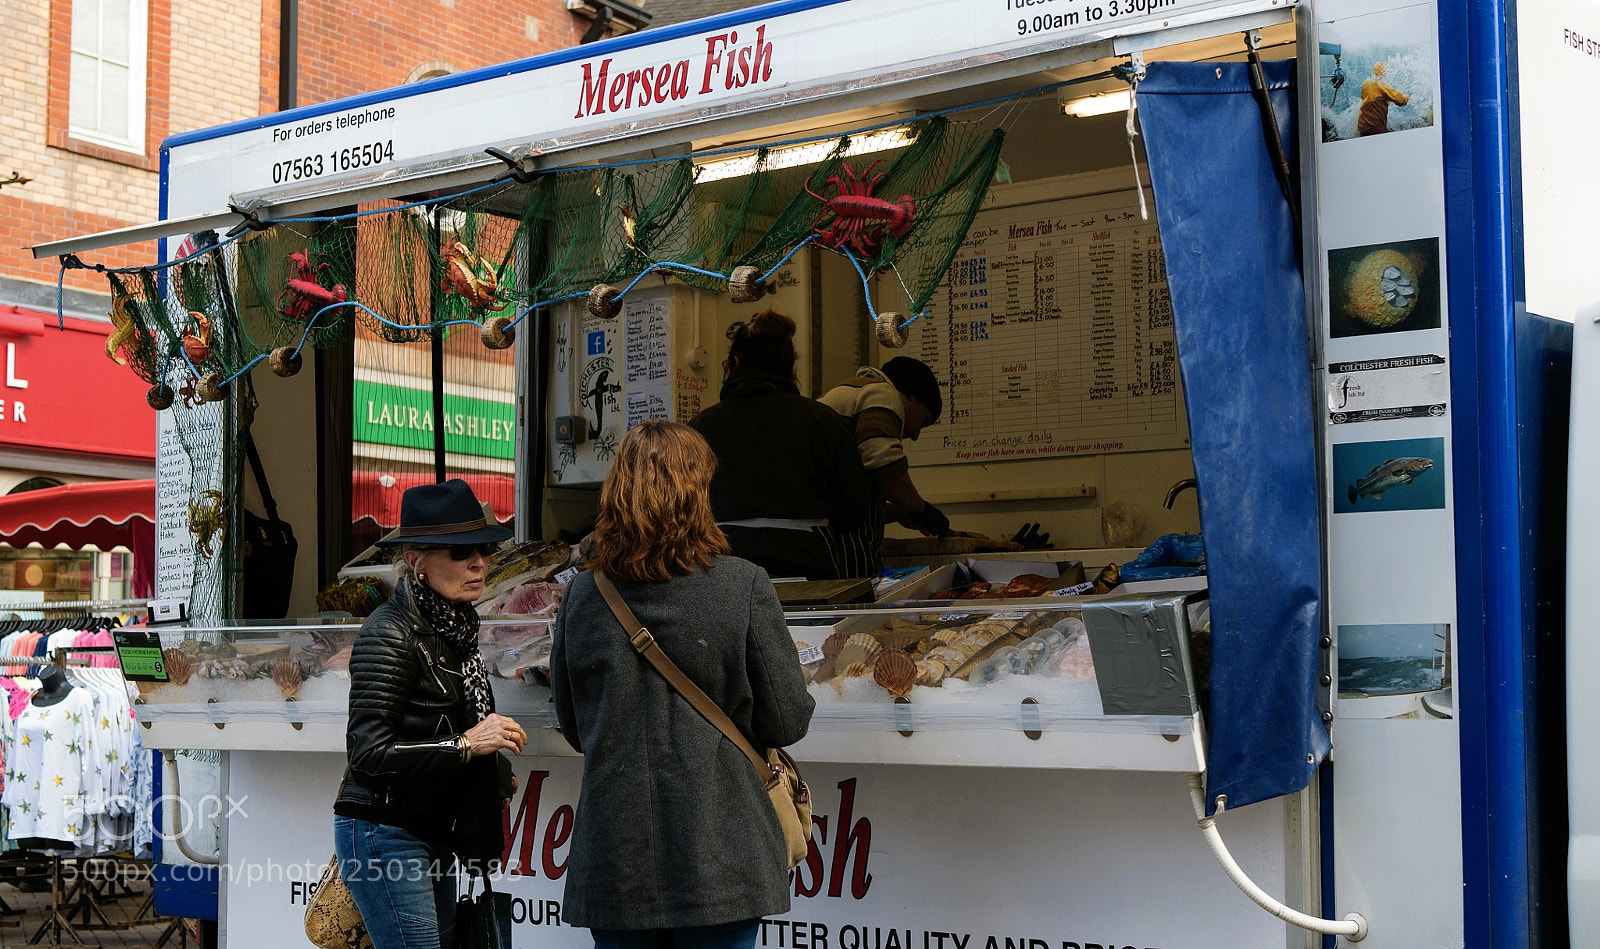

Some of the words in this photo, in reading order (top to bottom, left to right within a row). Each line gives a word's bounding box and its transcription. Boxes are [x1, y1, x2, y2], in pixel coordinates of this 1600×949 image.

[1017, 11, 1079, 35] 9.00am
[1085, 5, 1103, 22] to
[1108, 0, 1176, 17] 3.30pm
[1563, 27, 1584, 52] FISH
[574, 58, 690, 119] Mersea
[698, 24, 773, 95] Fish
[273, 128, 292, 142] For
[295, 120, 332, 138] orders
[336, 107, 396, 129] telephone
[273, 154, 323, 184] 07563
[330, 139, 395, 172] 165504
[1008, 224, 1034, 240] Mersea
[1035, 219, 1053, 236] Fish
[959, 238, 987, 249] heaper
[6, 342, 29, 389] L
[1001, 364, 1017, 374] Smoked
[1018, 363, 1028, 372] Fish
[1340, 361, 1389, 372] COLCHESTER
[1390, 359, 1415, 368] FRESH
[1416, 356, 1433, 365] FISH
[580, 358, 610, 408] COLCHESTER
[367, 401, 434, 432] LAURA
[443, 412, 514, 442] ASHLEY
[943, 436, 967, 448] Prices
[973, 438, 988, 447] can
[991, 435, 1023, 448] change
[1027, 430, 1053, 444] daily
[956, 450, 972, 460] Keep
[972, 450, 986, 459] your
[986, 448, 1000, 458] fish
[1000, 447, 1015, 456] here
[1038, 444, 1056, 453] while
[1057, 443, 1075, 453] doing
[1076, 444, 1092, 452] your
[1092, 441, 1125, 451] shopping.
[159, 468, 185, 479] Mackerel
[160, 459, 186, 470] Sardines
[159, 530, 175, 540] Hake
[158, 561, 181, 571] Salmon
[760, 919, 828, 949] TTER
[839, 924, 971, 949] QUALITY
